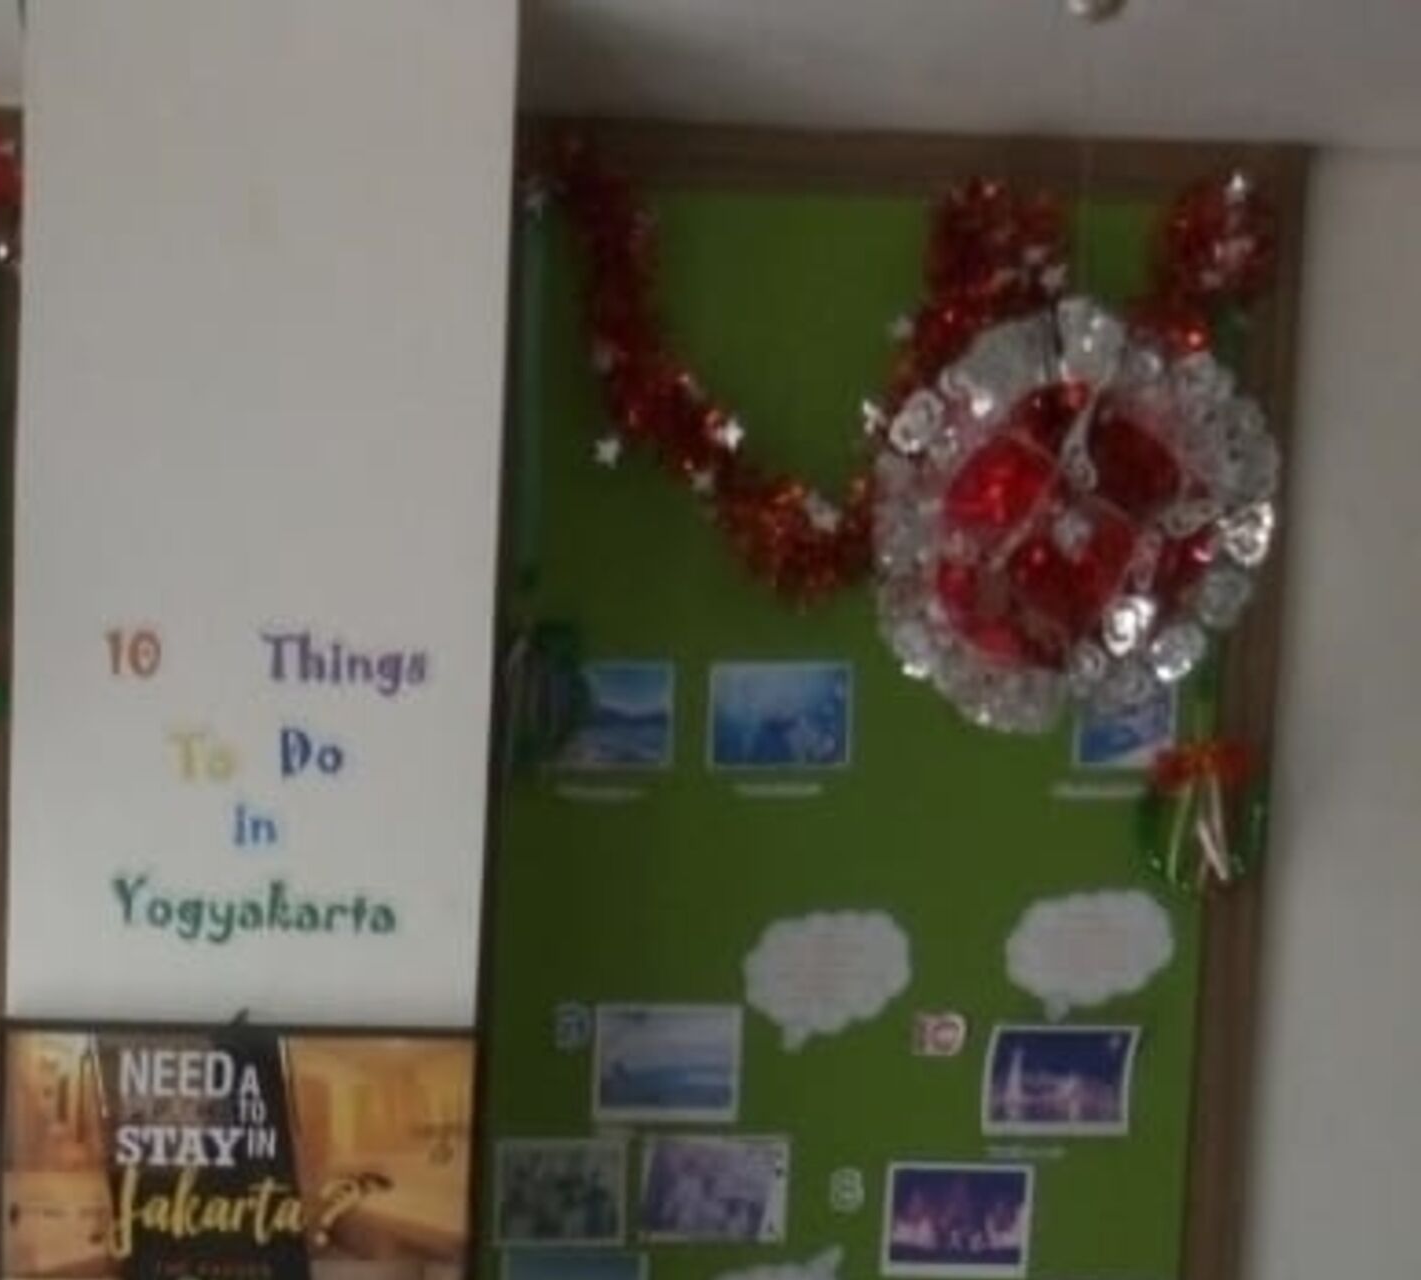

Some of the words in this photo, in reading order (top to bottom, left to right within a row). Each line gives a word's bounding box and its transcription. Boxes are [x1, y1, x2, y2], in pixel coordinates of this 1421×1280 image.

[105, 630, 162, 678] 10
[260, 632, 428, 696] Things
[167, 730, 237, 781] To
[279, 726, 344, 778] Do
[112, 876, 397, 944] Yogyakarta
[120, 1050, 235, 1097] NEED
[240, 1065, 261, 1097] A
[116, 1124, 245, 1166] STAY
[247, 1127, 276, 1159] IN
